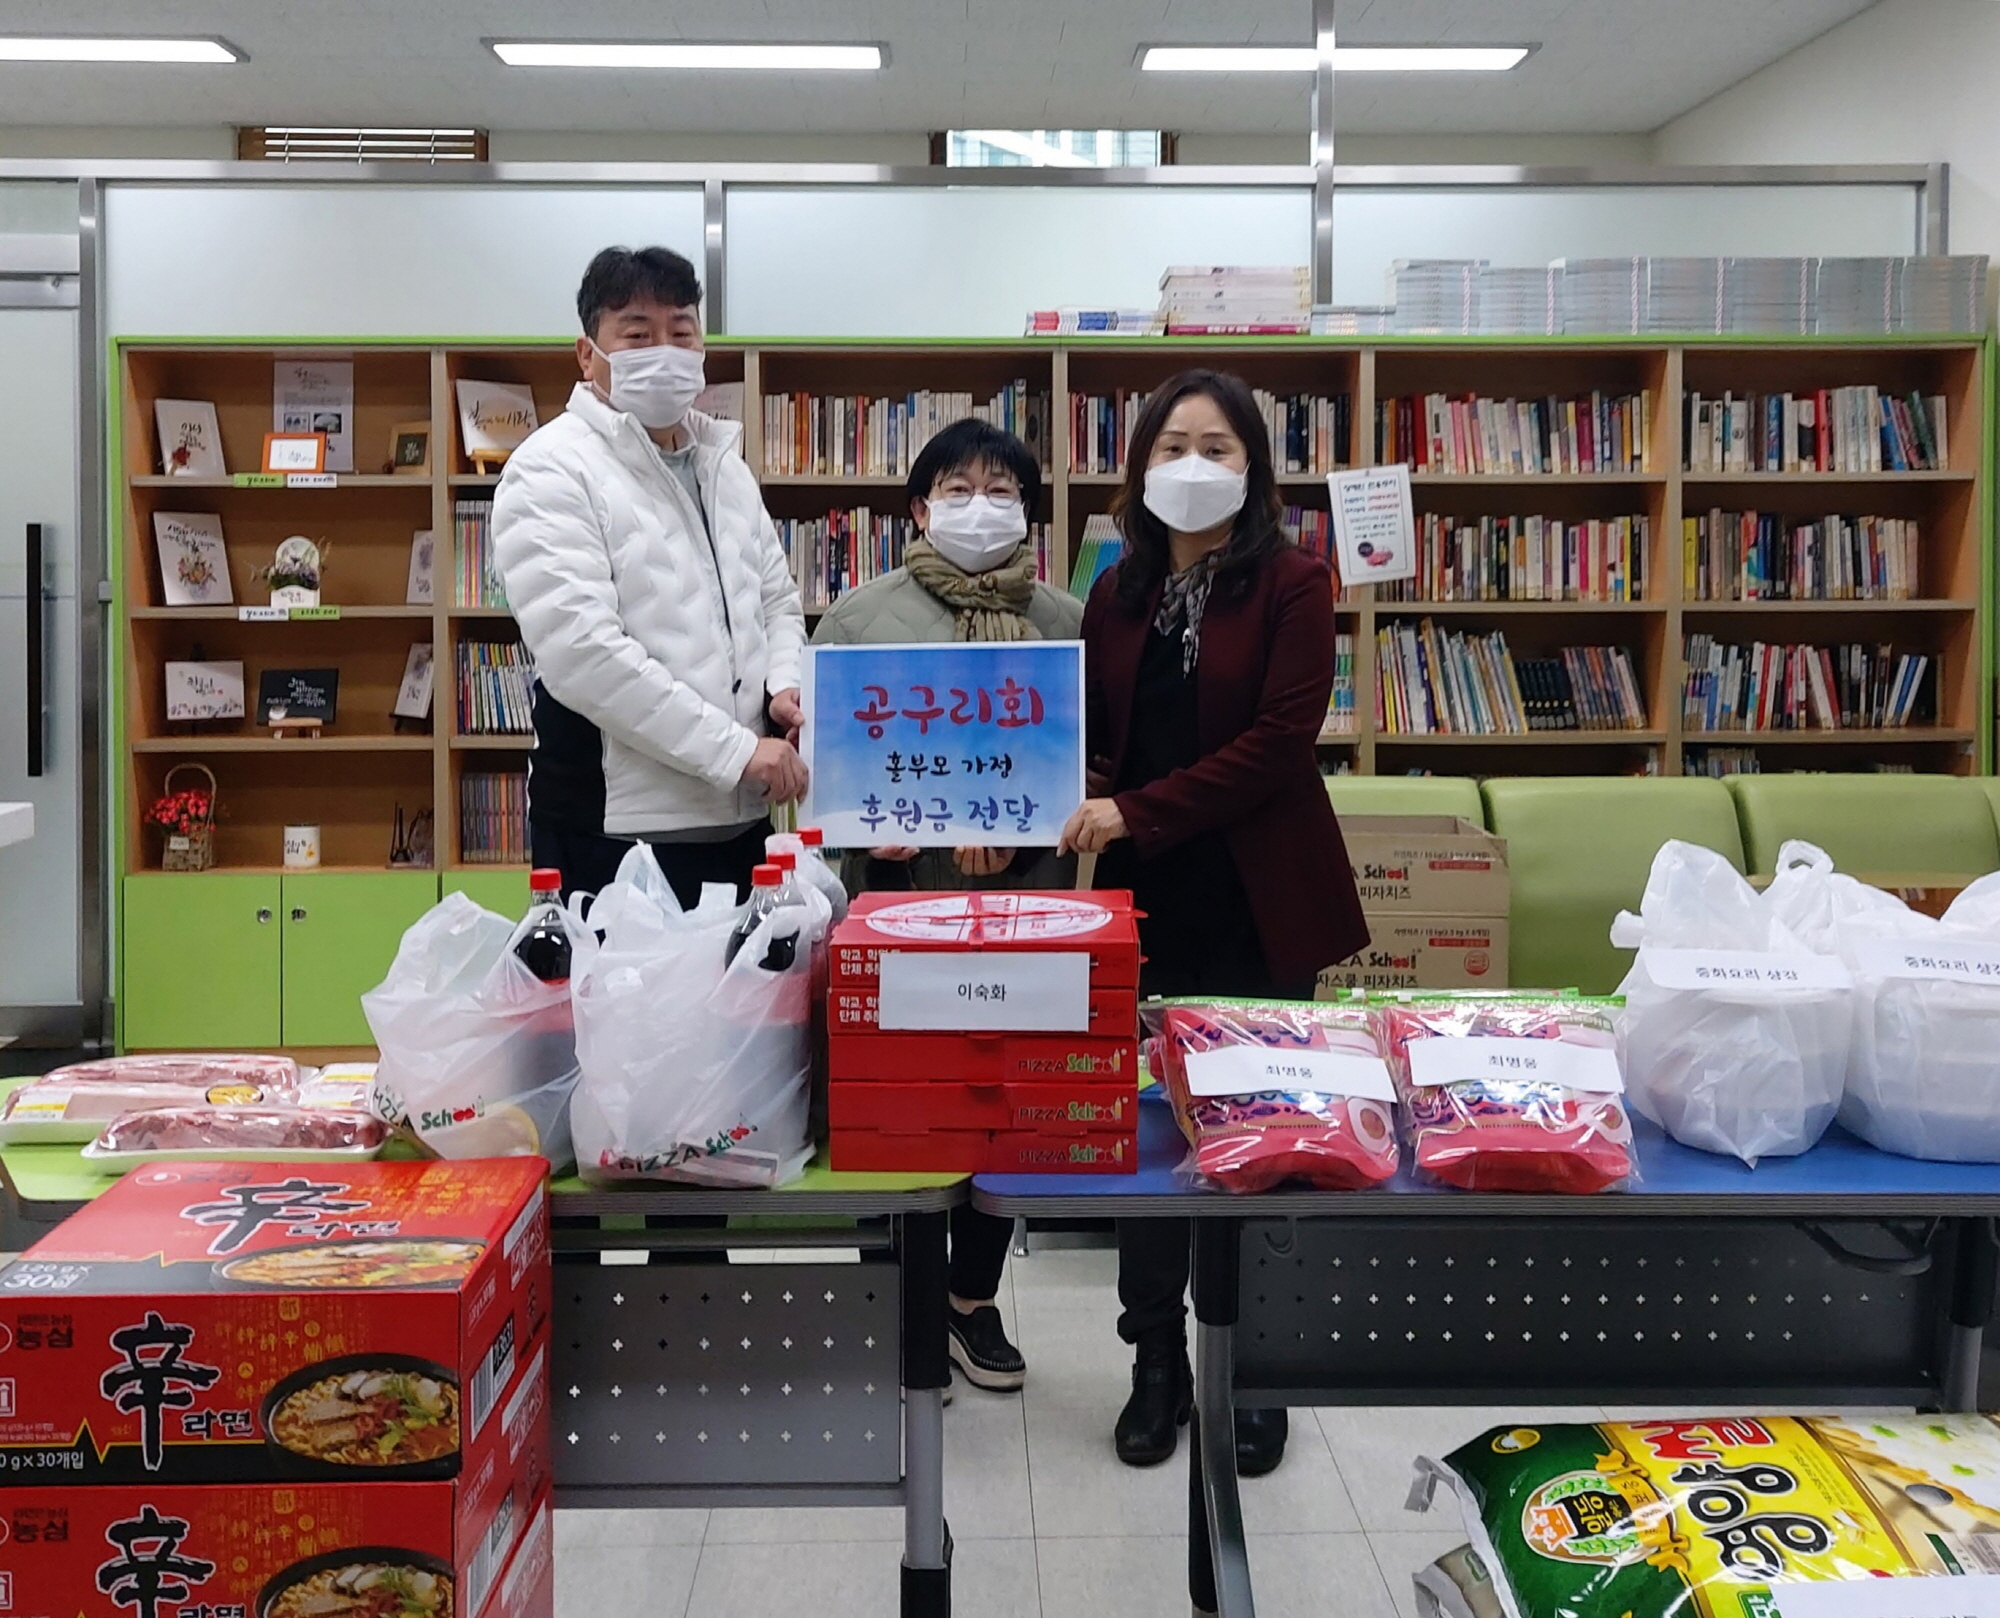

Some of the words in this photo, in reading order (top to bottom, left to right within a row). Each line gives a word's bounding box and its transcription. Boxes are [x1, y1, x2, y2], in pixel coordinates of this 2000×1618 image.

[854, 676, 1044, 740] 공구리회
[961, 753, 1013, 780] 가정
[859, 793, 953, 834] 후원금
[967, 794, 1039, 834] 전달
[1360, 885, 1412, 900] 피자치즈
[958, 983, 1006, 1001] 이숙화
[1364, 974, 1419, 989] 피자치즈
[1018, 1059, 1066, 1073] PIZZA
[1019, 1106, 1066, 1121] PIZZA
[1020, 1150, 1067, 1163] PIZZA
[101, 1311, 219, 1471] 辛
[182, 1408, 253, 1440] 라면
[1573, 1495, 1614, 1534] 일등
